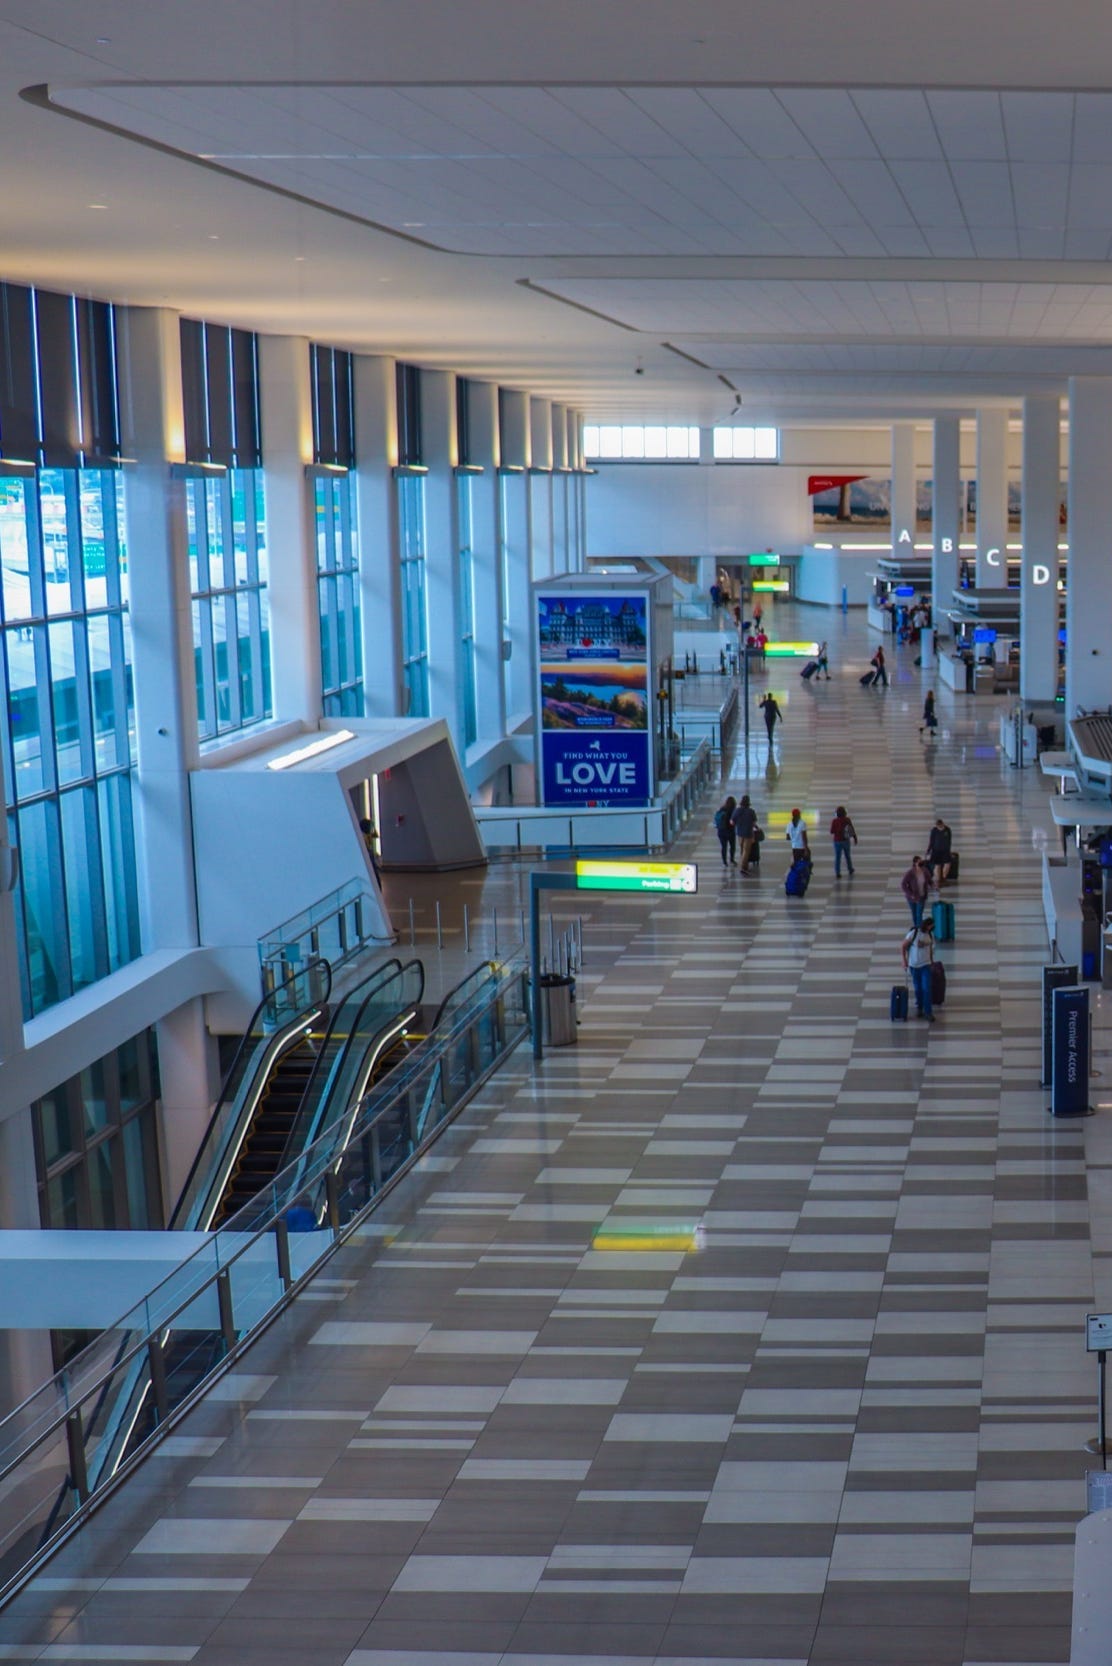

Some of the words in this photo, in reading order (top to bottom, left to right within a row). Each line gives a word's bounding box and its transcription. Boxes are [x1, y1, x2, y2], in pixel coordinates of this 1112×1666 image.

[898, 529, 911, 543] A
[941, 538, 953, 552] B
[986, 549, 1000, 566] C
[1032, 565, 1049, 584] D
[556, 762, 636, 785] LOVE
[1068, 1010, 1078, 1049] Premier
[1068, 1050, 1077, 1083] Access
